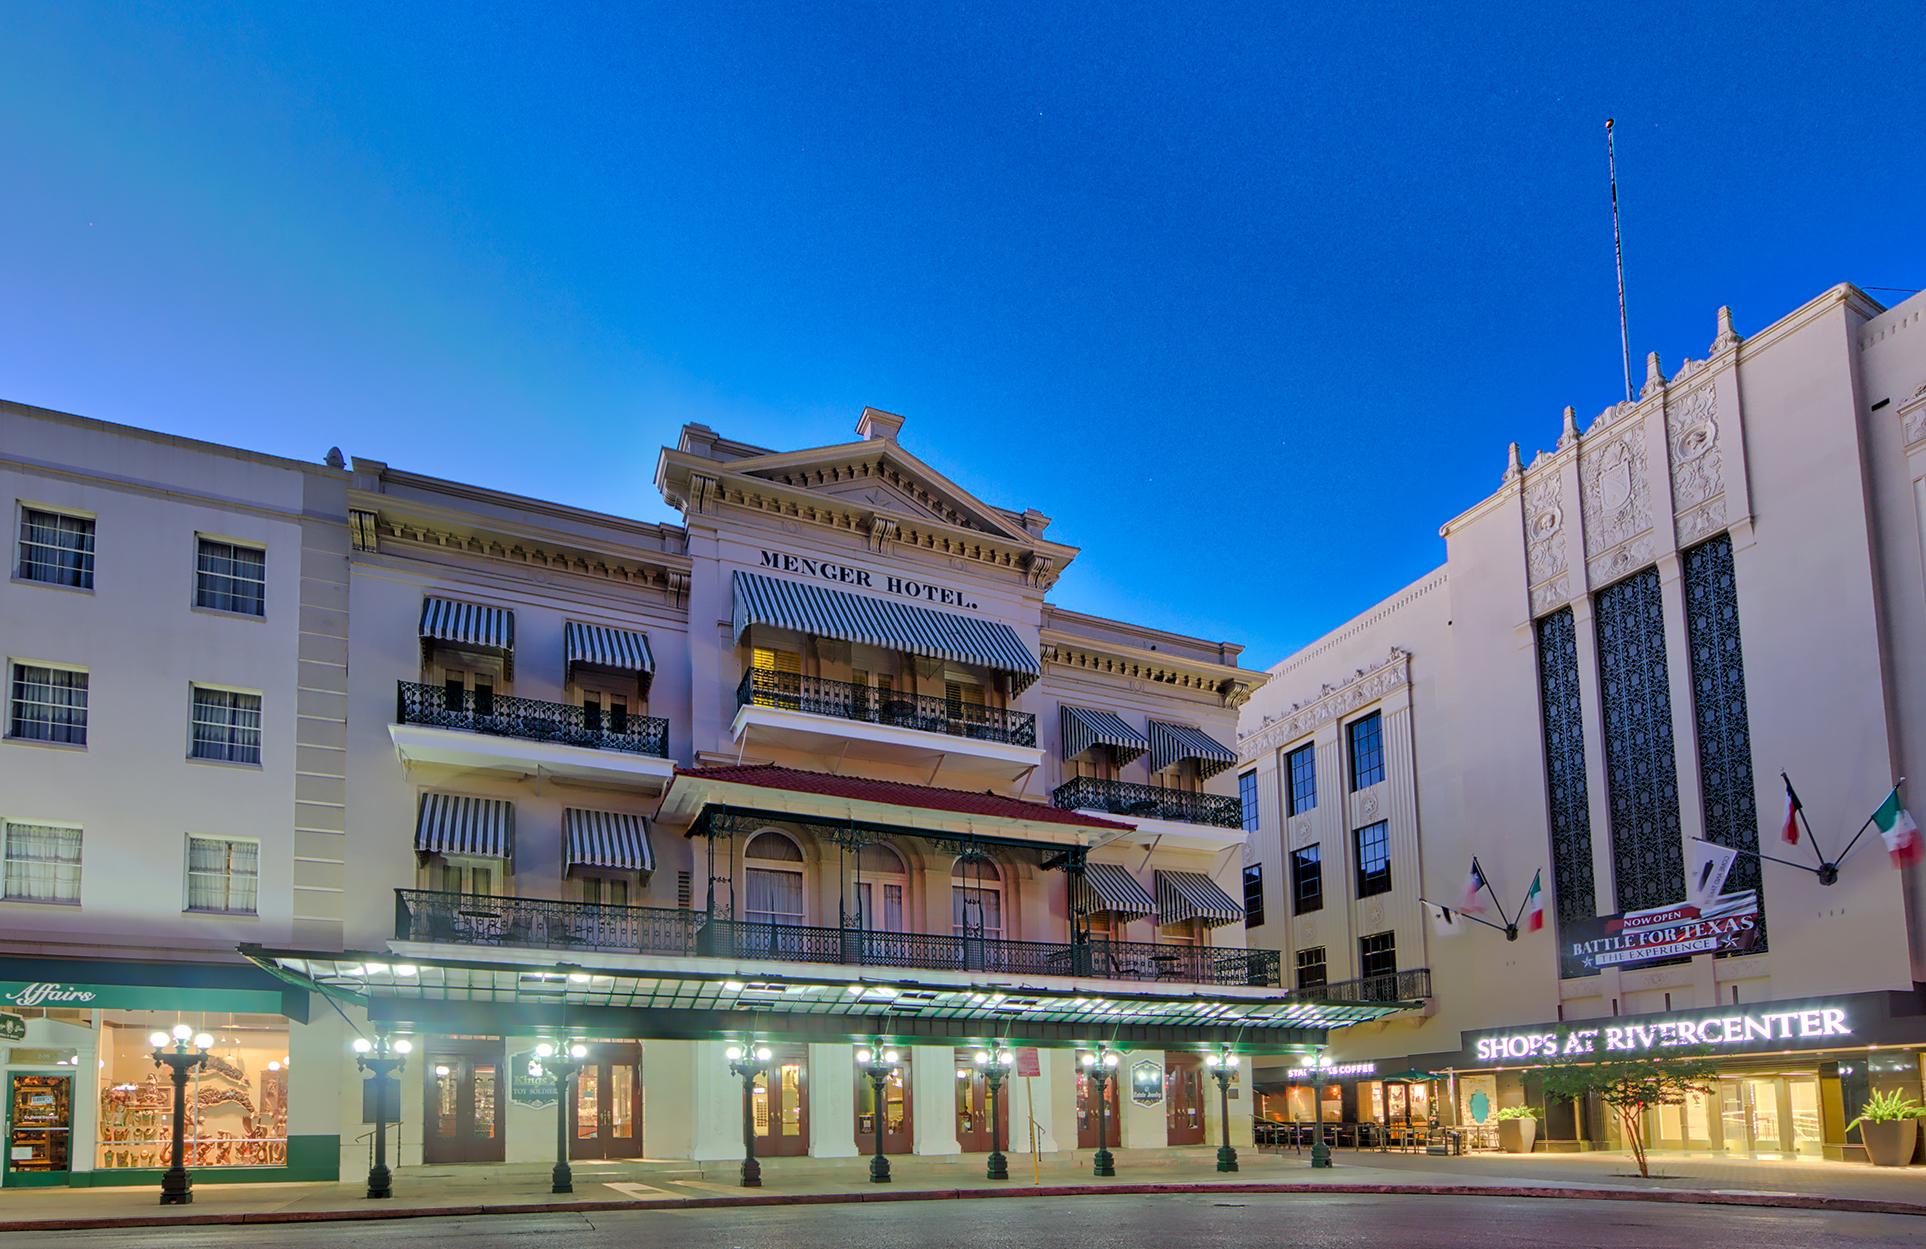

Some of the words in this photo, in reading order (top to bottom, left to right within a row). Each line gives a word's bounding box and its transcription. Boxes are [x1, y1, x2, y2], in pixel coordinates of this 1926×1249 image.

[760, 550, 872, 587] MENGER
[886, 576, 978, 609] HOTEL.
[1624, 915, 1653, 928] NOW
[1653, 910, 1681, 924] OPEN
[1573, 933, 1636, 956] BATTLE
[1639, 928, 1678, 946] FOR
[1679, 915, 1755, 940] TEXAS
[1600, 953, 1625, 964] THE
[1629, 939, 1711, 960] EXPERIENCE
[5, 982, 96, 1006] Affairs
[1477, 1032, 1558, 1060] SHOPS
[1562, 1029, 1599, 1055] AT
[1605, 1008, 1852, 1050] RIVERCENTER
[1338, 1062, 1376, 1075] COFFEE
